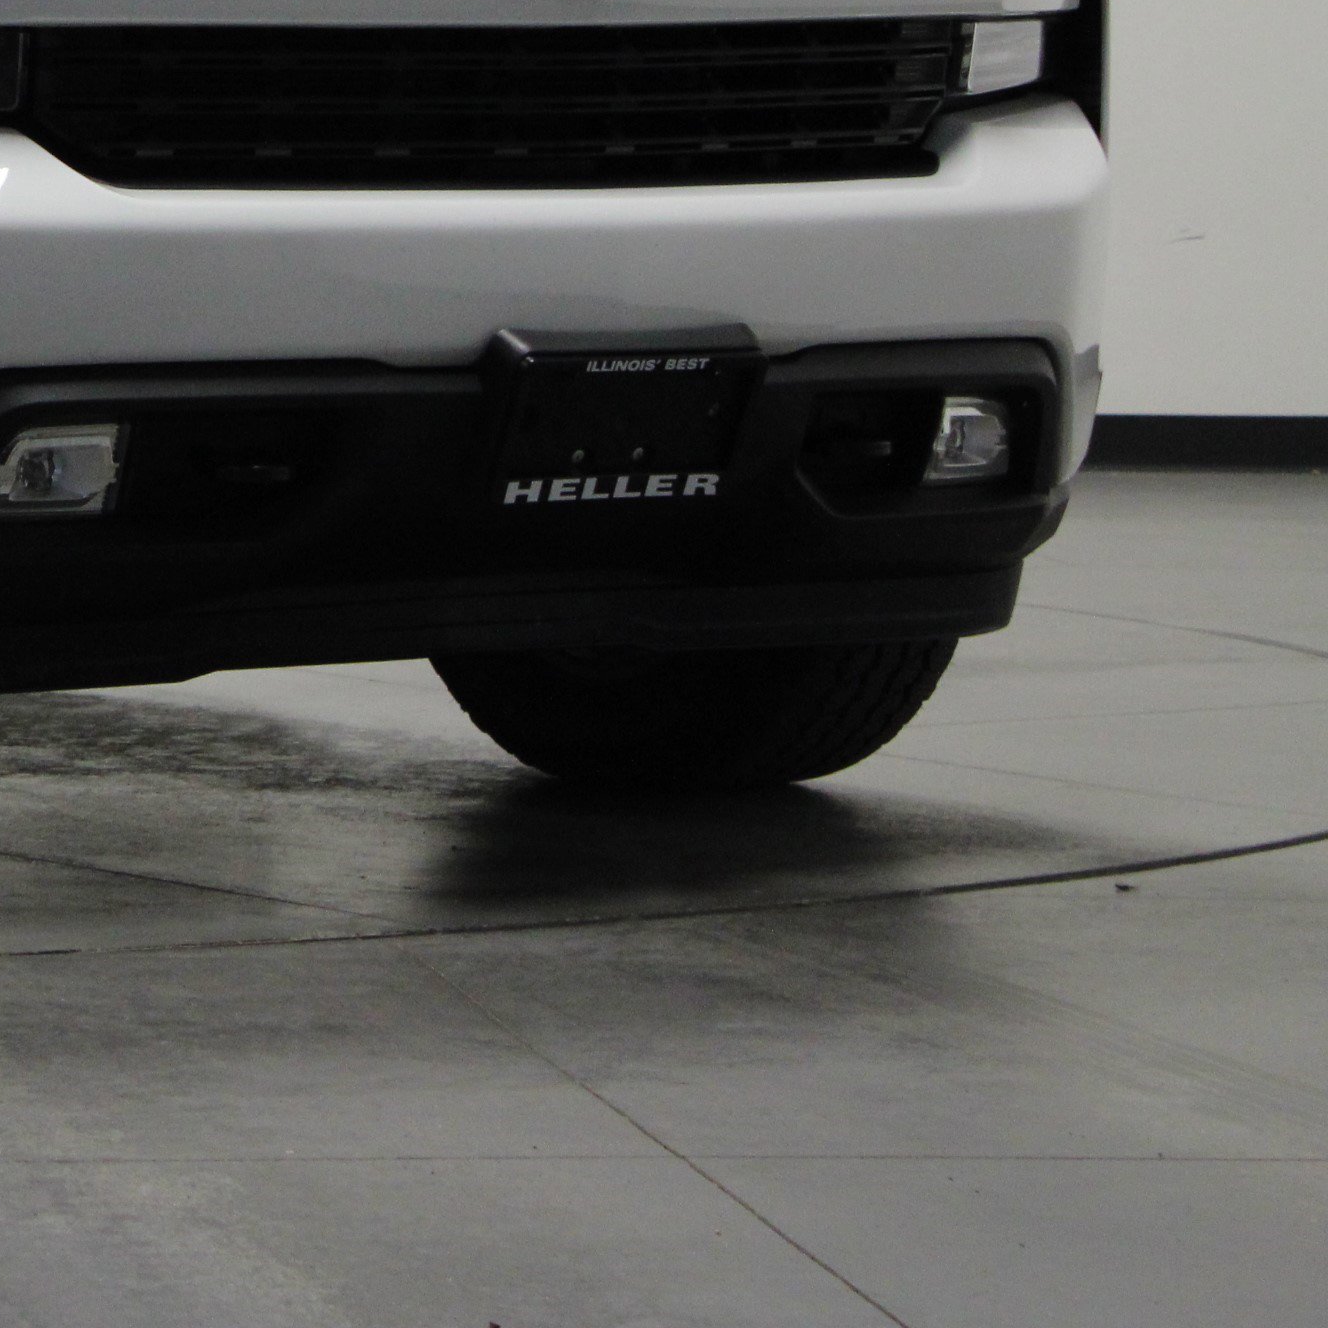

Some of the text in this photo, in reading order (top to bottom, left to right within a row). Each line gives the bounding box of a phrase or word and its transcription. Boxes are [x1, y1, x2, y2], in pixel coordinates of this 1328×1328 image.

[586, 356, 710, 372] ILLINOIS' BEST
[503, 473, 720, 505] HELLER
